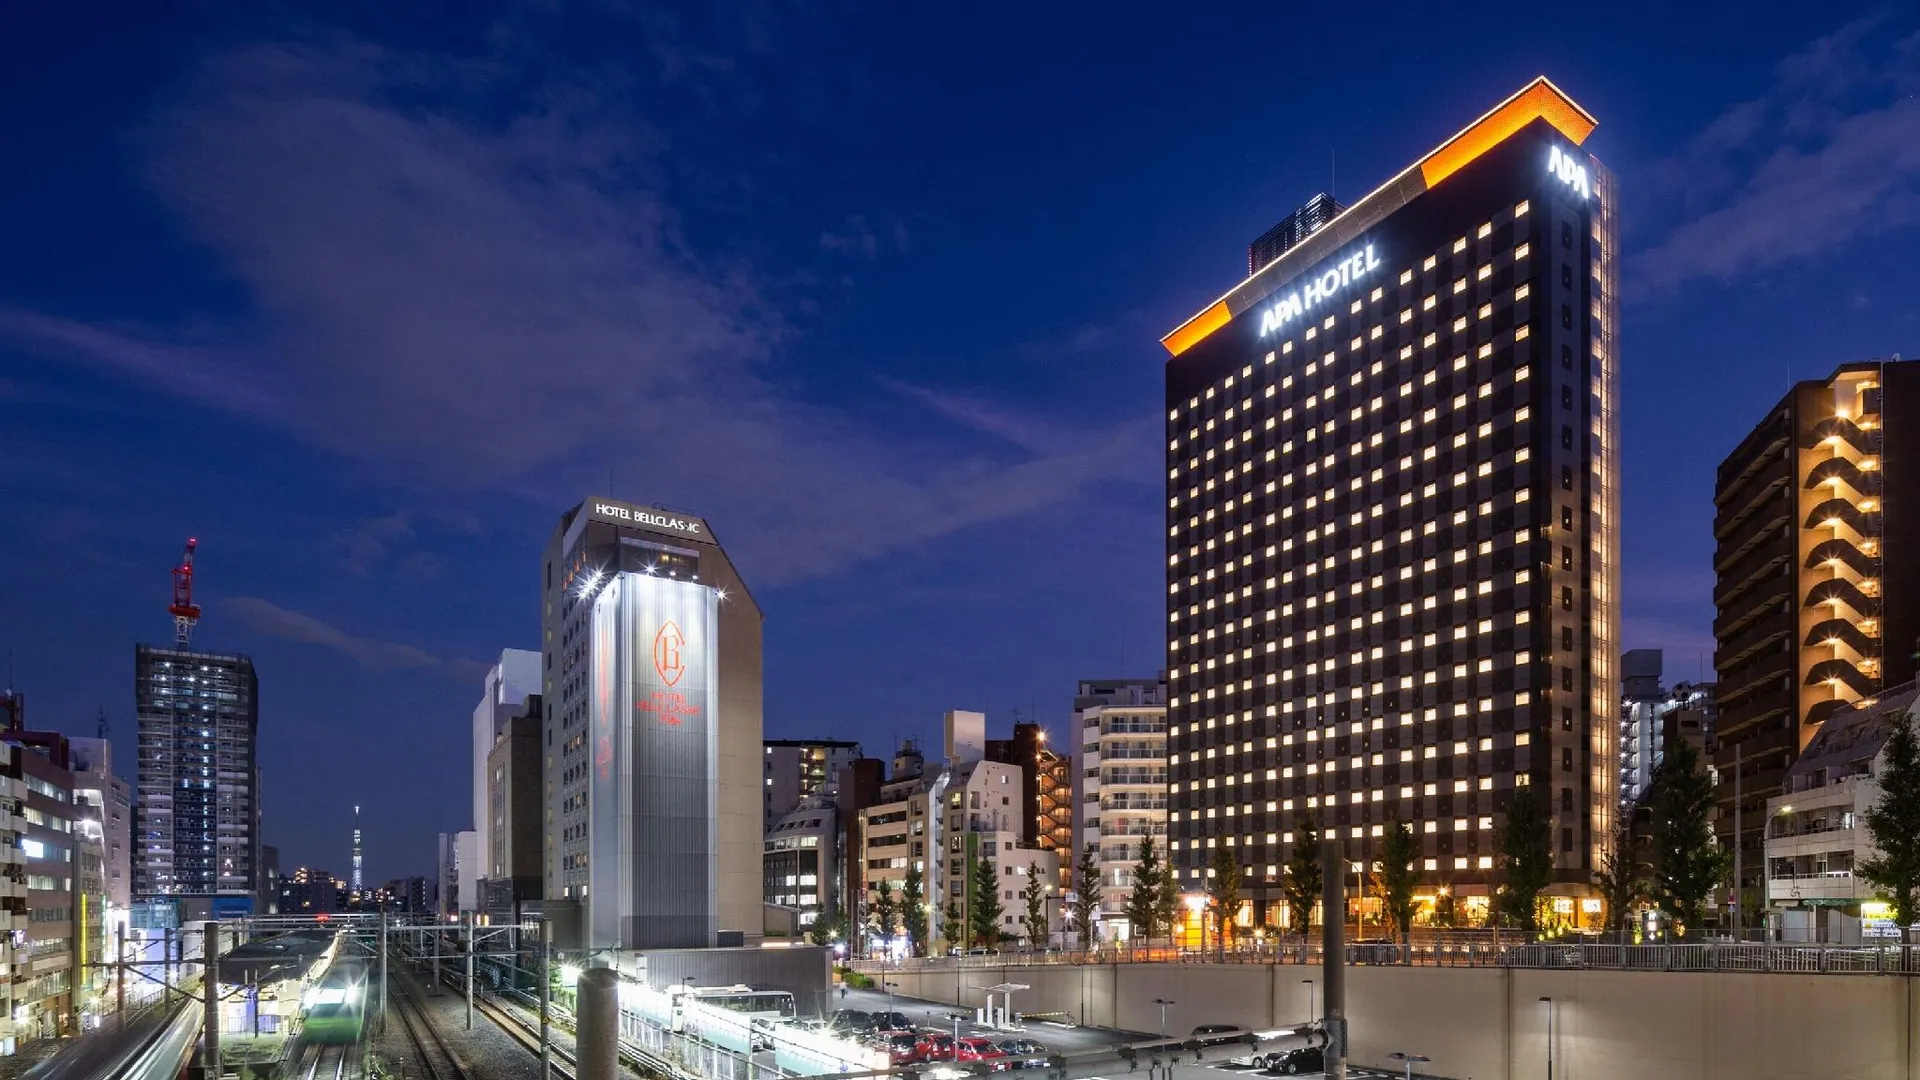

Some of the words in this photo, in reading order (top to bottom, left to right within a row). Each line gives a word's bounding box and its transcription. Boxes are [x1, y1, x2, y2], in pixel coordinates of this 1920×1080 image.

[1548, 145, 1589, 199] APA
[1260, 292, 1302, 338] APA
[1303, 244, 1380, 310] HOTEL
[595, 503, 632, 520] HOTEL
